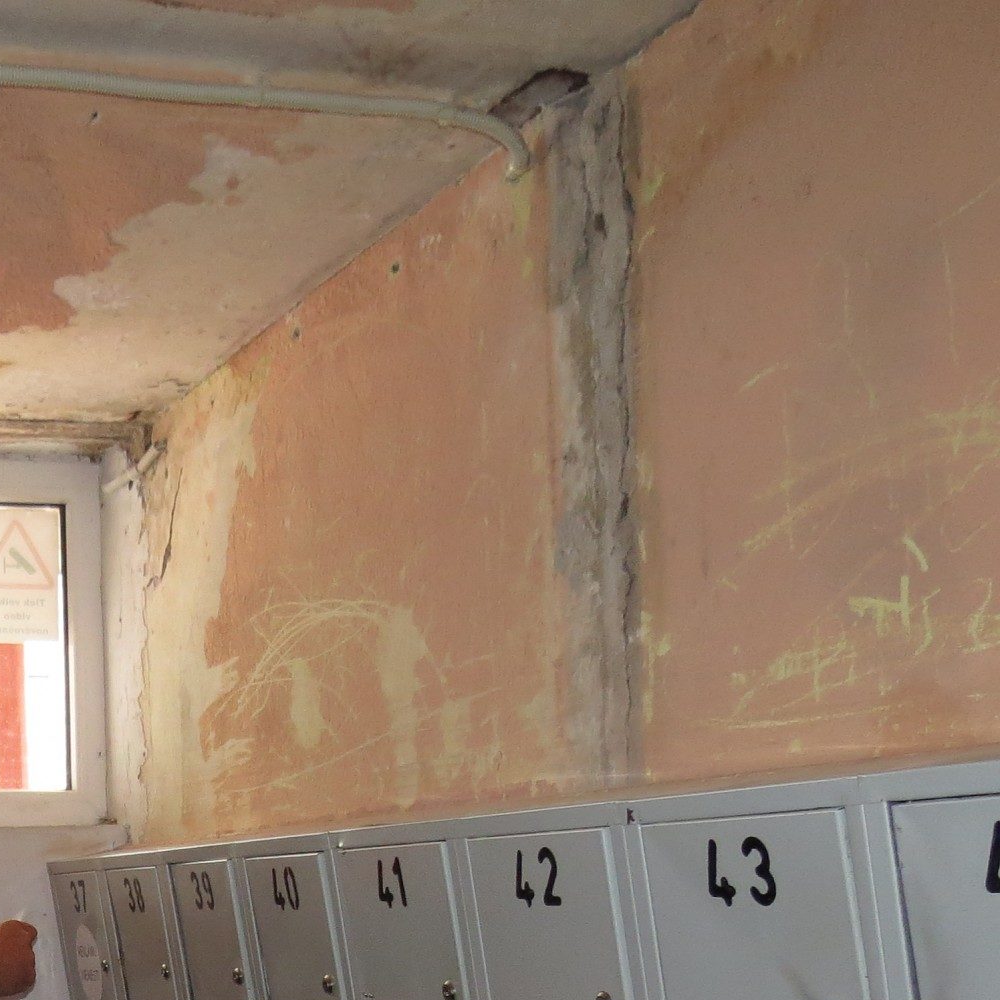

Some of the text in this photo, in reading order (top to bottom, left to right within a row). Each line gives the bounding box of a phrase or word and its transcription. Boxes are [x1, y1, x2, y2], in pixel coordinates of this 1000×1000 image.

[191, 872, 214, 910] 39
[272, 867, 299, 910] 40
[378, 857, 407, 908] 41
[516, 847, 561, 907] 42
[708, 837, 776, 906] 43
[70, 880, 86, 913] 37
[124, 878, 145, 913] 38
